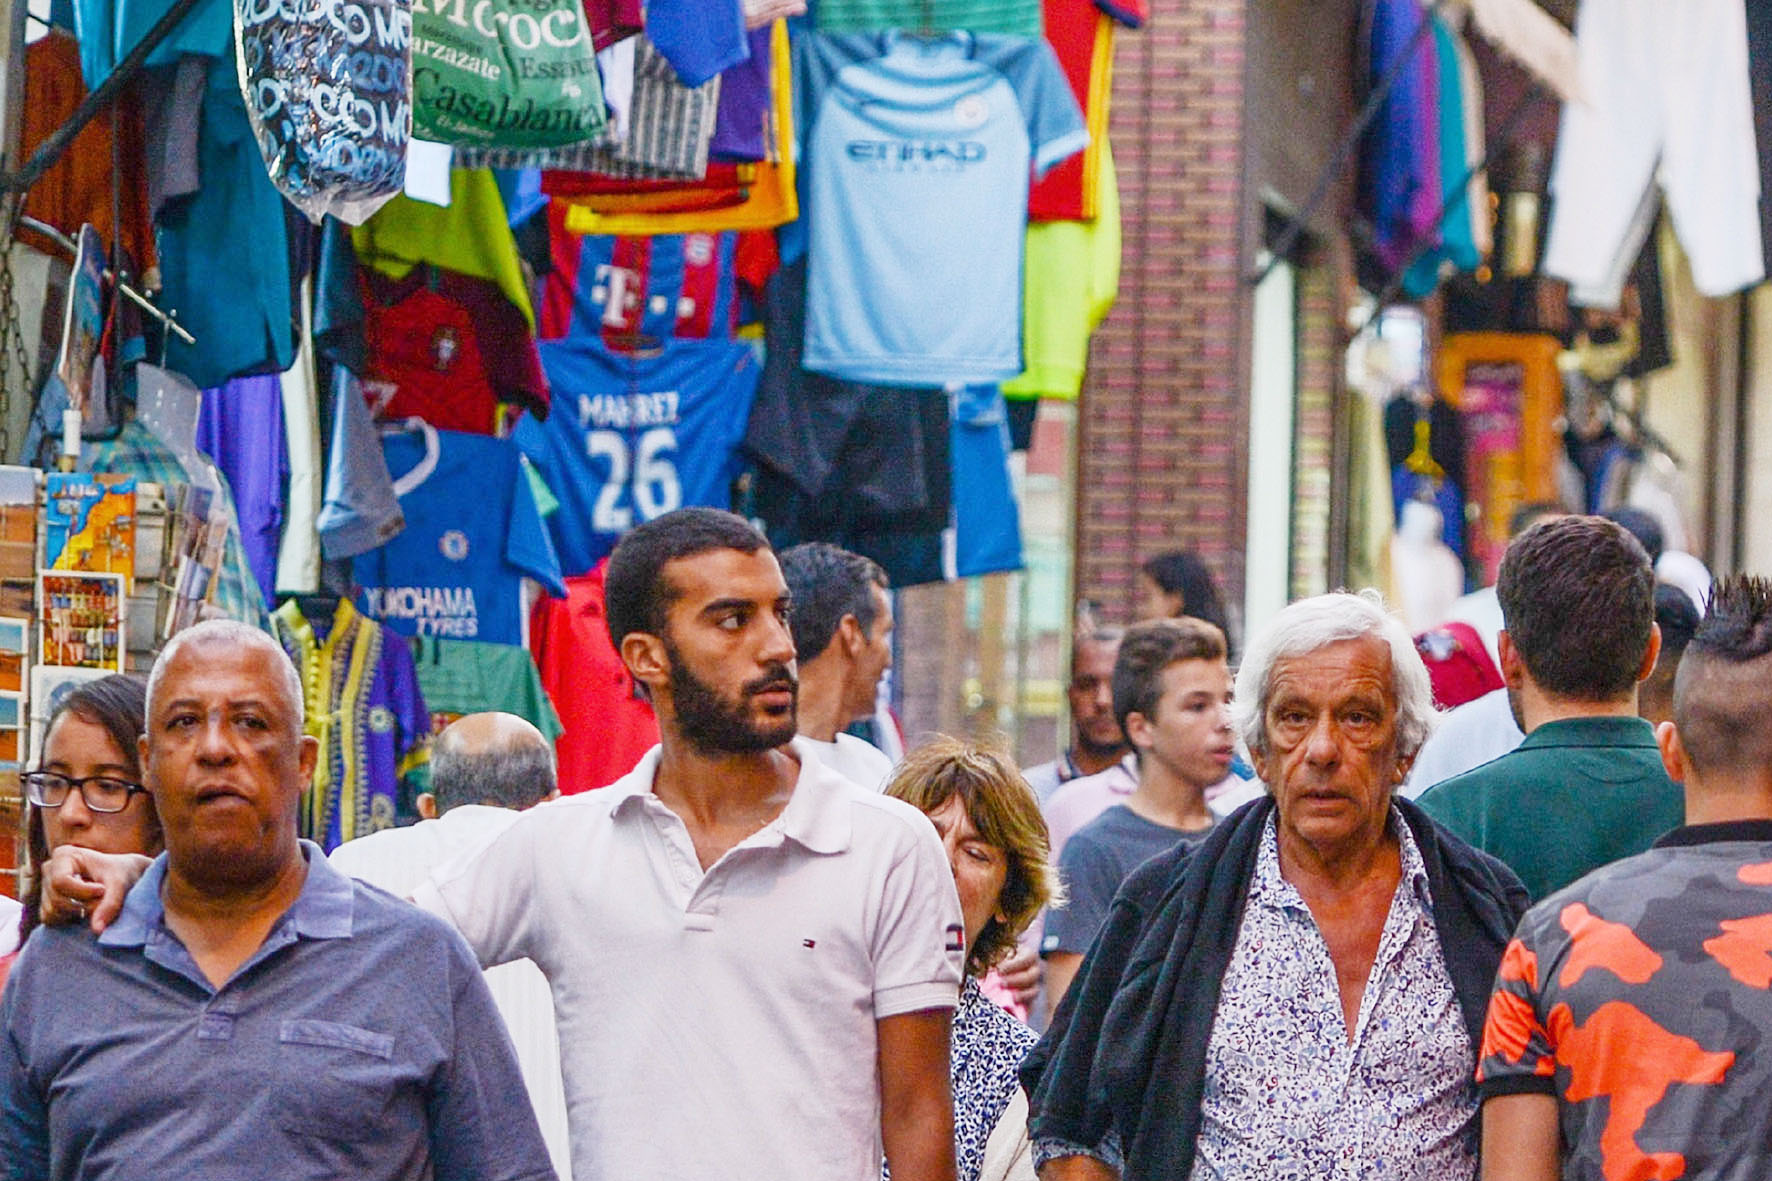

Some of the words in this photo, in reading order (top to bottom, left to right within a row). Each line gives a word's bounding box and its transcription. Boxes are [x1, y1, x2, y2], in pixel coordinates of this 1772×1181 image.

[587, 427, 682, 533] 26
[363, 586, 478, 618] YOKOHAMA
[416, 616, 478, 638] TYRES
